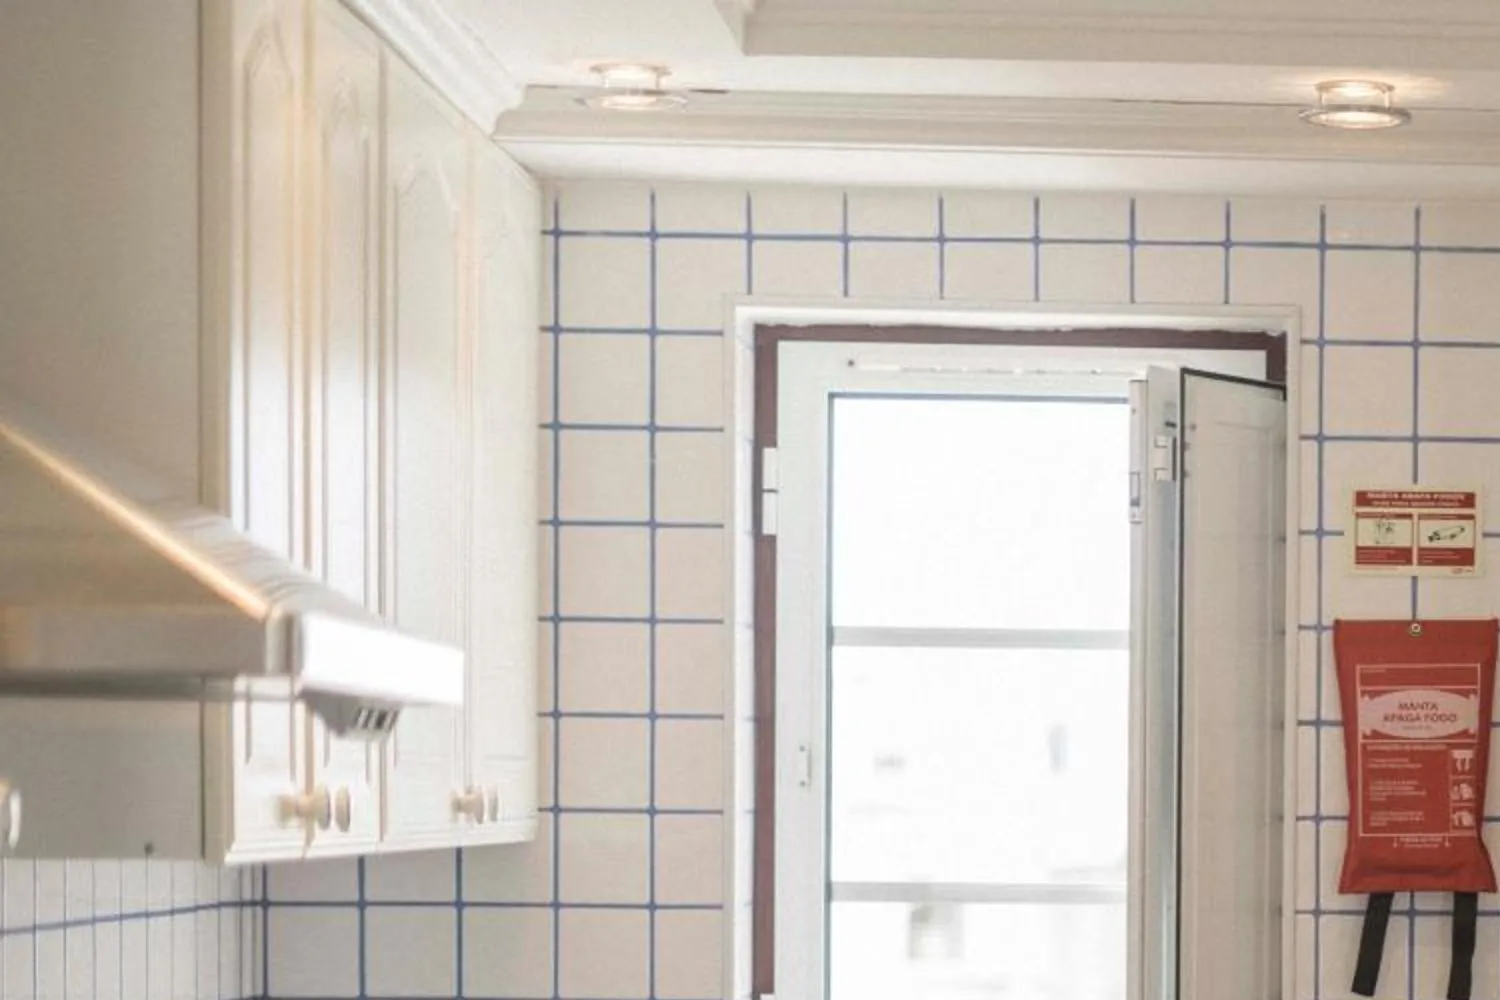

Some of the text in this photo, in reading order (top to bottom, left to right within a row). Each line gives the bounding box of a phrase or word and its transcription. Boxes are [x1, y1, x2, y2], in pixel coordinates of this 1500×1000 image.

[1398, 702, 1439, 711] MANTA
[1382, 713, 1457, 722] APAGA FOGO
